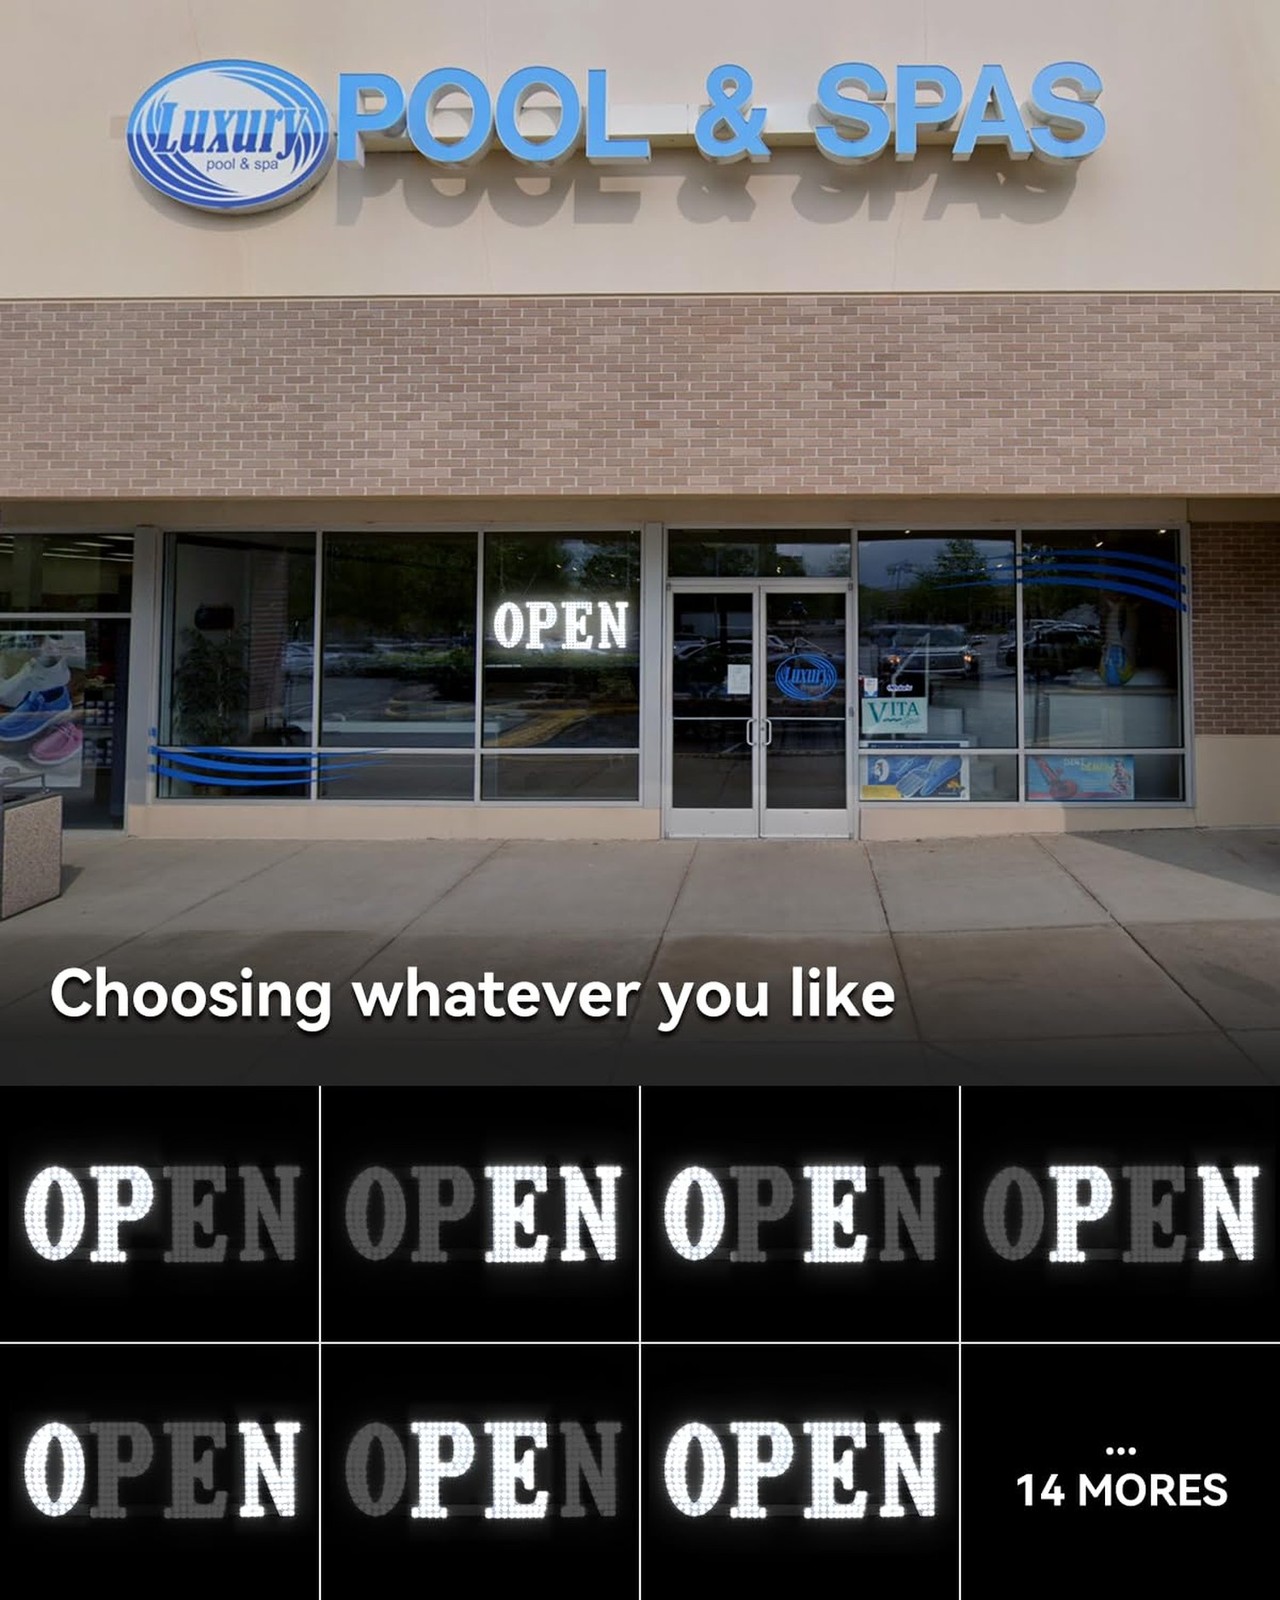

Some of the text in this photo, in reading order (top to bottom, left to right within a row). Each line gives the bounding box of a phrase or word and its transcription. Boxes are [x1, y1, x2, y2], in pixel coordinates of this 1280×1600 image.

[152, 102, 308, 160] Luxury
[336, 61, 1108, 164] POOL & SPAS
[206, 158, 279, 172] pool & spa
[493, 601, 629, 650] OPEN
[868, 701, 919, 723] VITA
[23, 1165, 301, 1263] OPEN
[345, 1165, 622, 1263] OPEN
[664, 1165, 941, 1263] OPEN
[983, 1165, 1260, 1263] OPEN
[23, 1421, 301, 1519] OPEN
[345, 1421, 622, 1519] OPEN
[664, 1421, 941, 1519] OPEN
